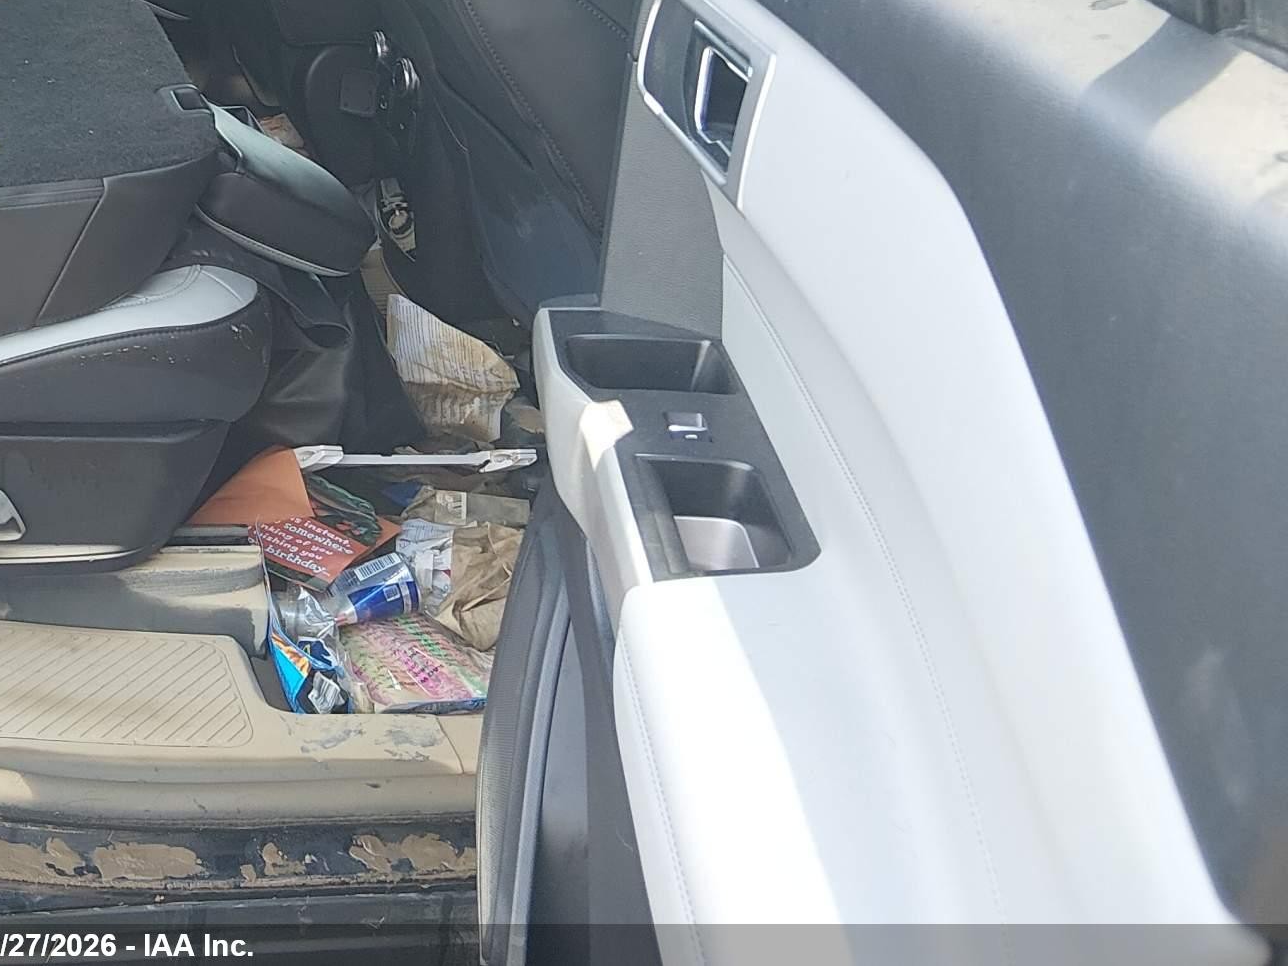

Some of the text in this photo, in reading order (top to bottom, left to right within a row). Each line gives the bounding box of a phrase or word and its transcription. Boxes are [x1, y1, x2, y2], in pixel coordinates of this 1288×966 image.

[283, 522, 355, 555] somewhere
[303, 520, 352, 548] instant,
[295, 538, 311, 547] of
[311, 544, 334, 556] you
[299, 550, 324, 561] you
